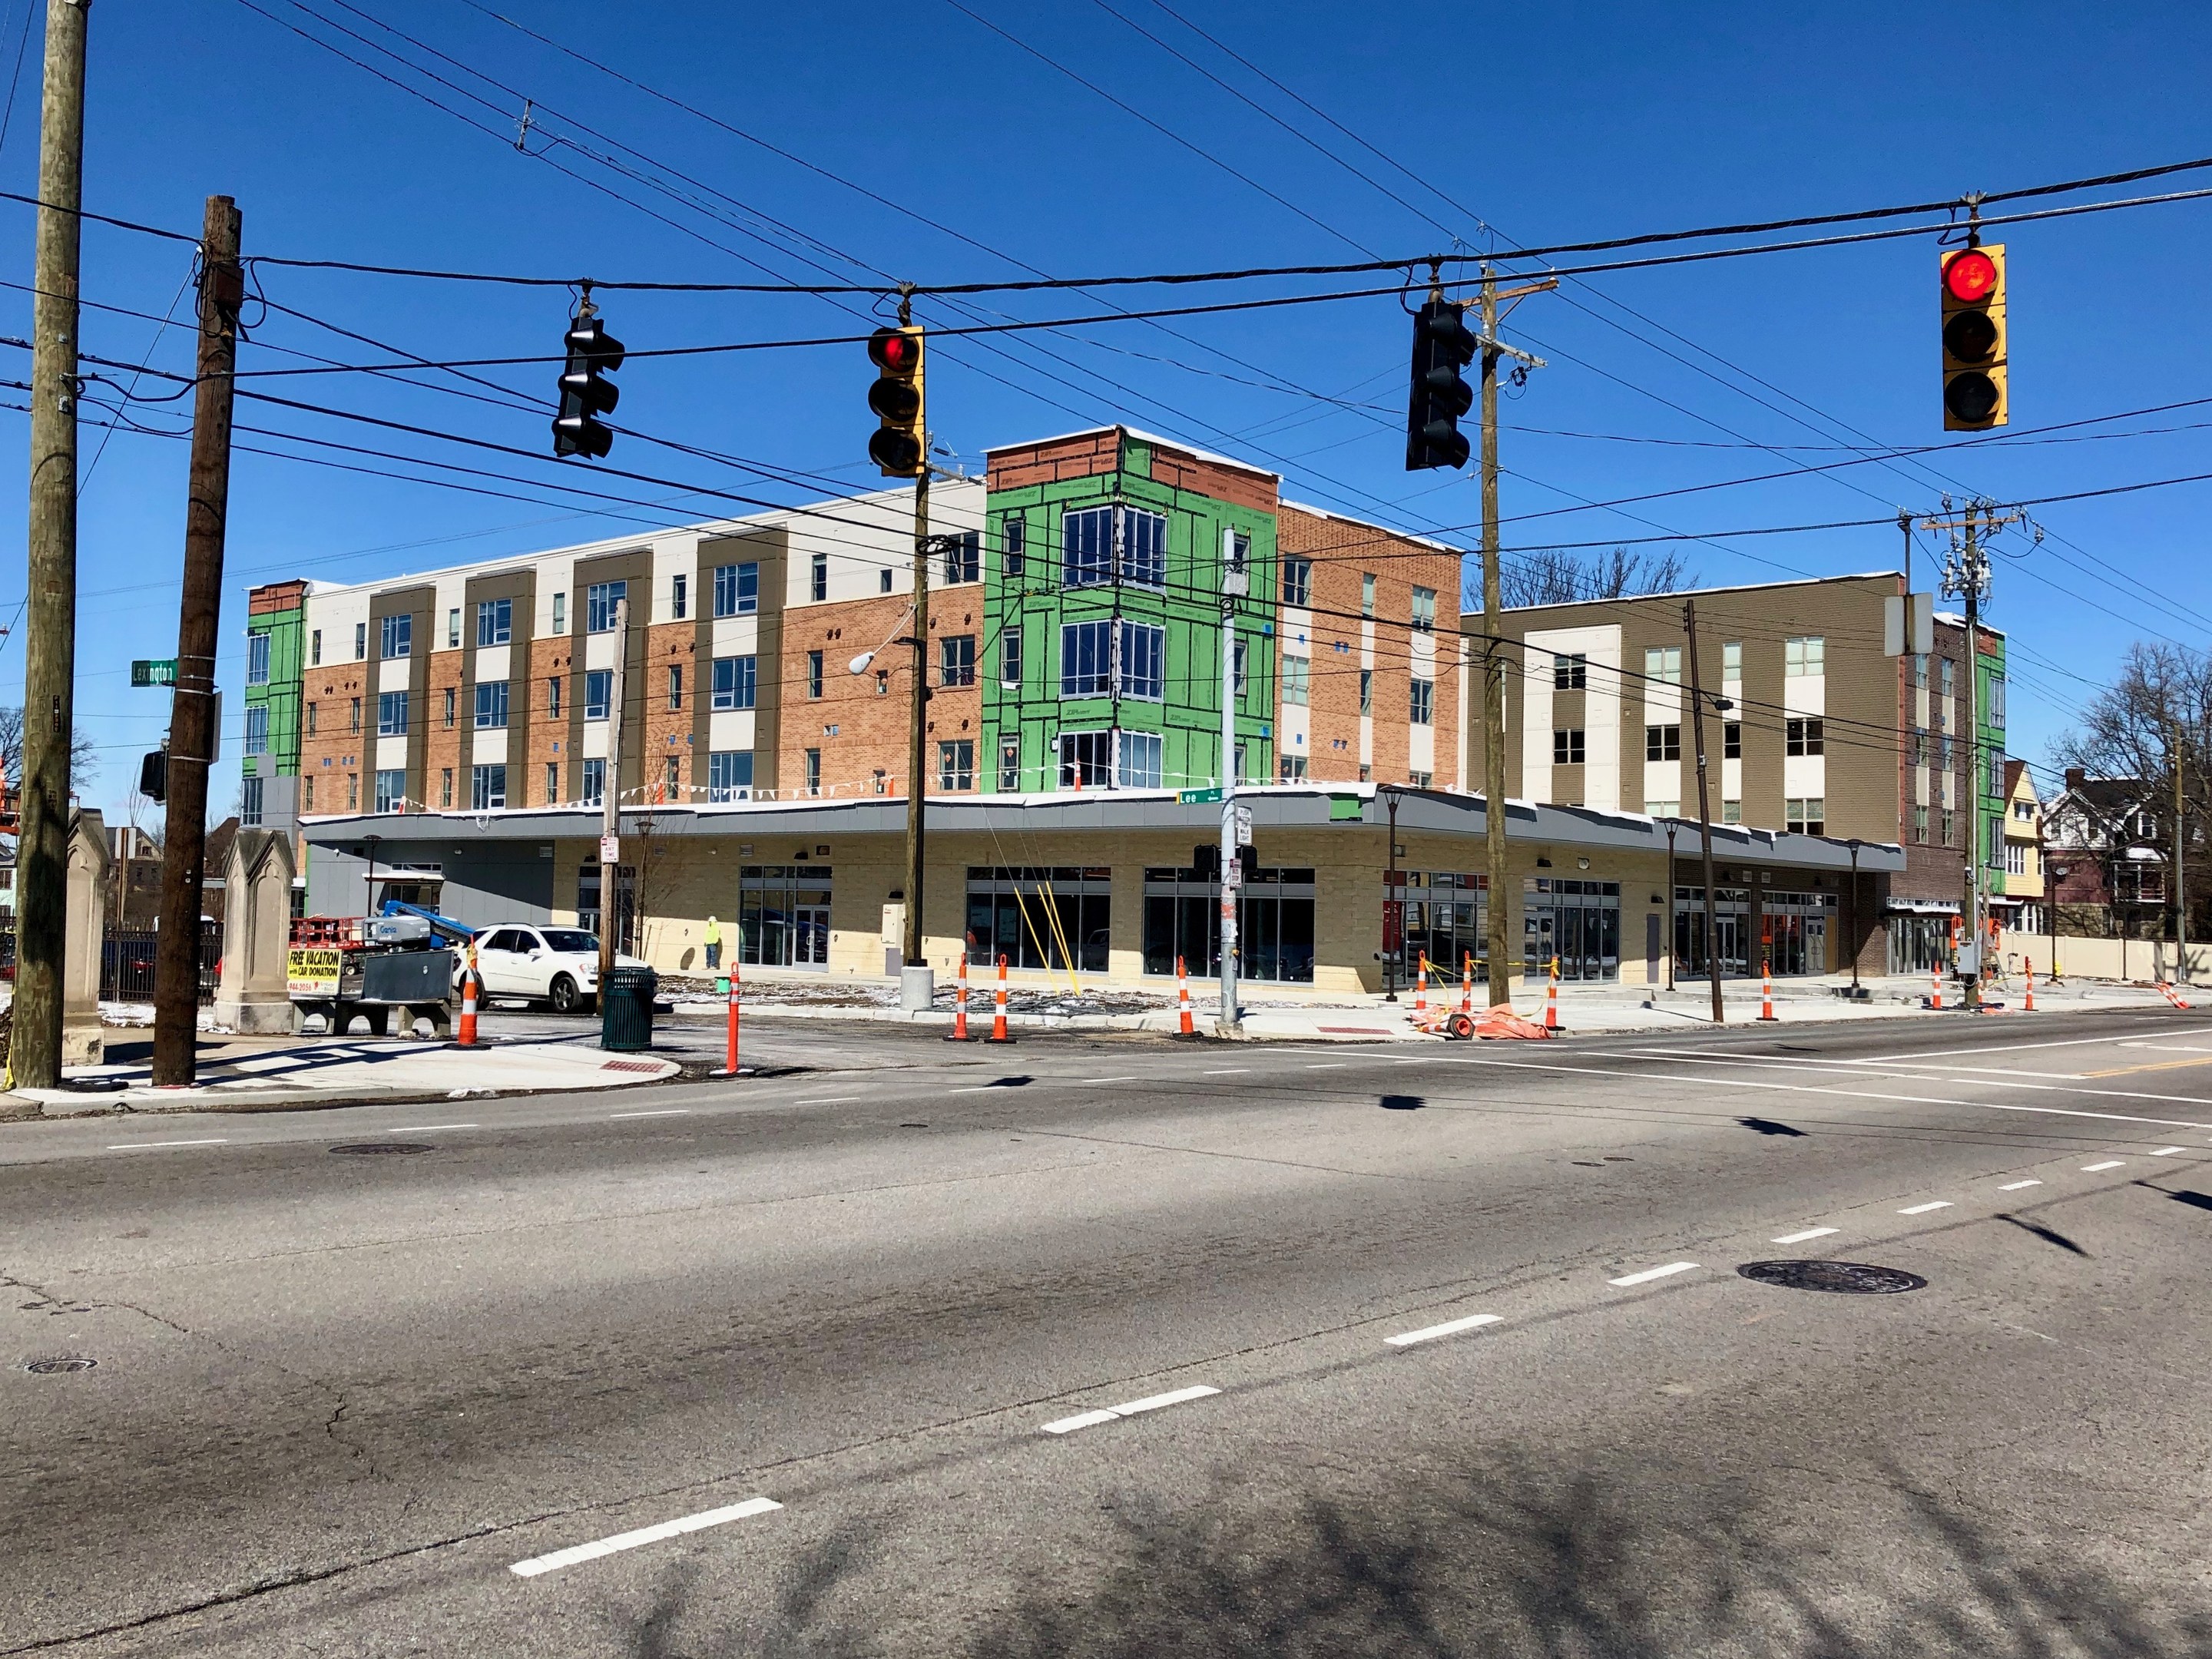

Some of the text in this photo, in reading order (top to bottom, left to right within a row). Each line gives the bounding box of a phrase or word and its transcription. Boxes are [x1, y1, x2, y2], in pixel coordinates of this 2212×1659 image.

[133, 663, 173, 684] Lexington
[1180, 793, 1196, 803] Lee
[379, 926, 397, 934] Genie
[289, 951, 339, 966] FREE VACATION
[298, 966, 308, 976] CAR
[309, 967, 338, 977] DONATION
